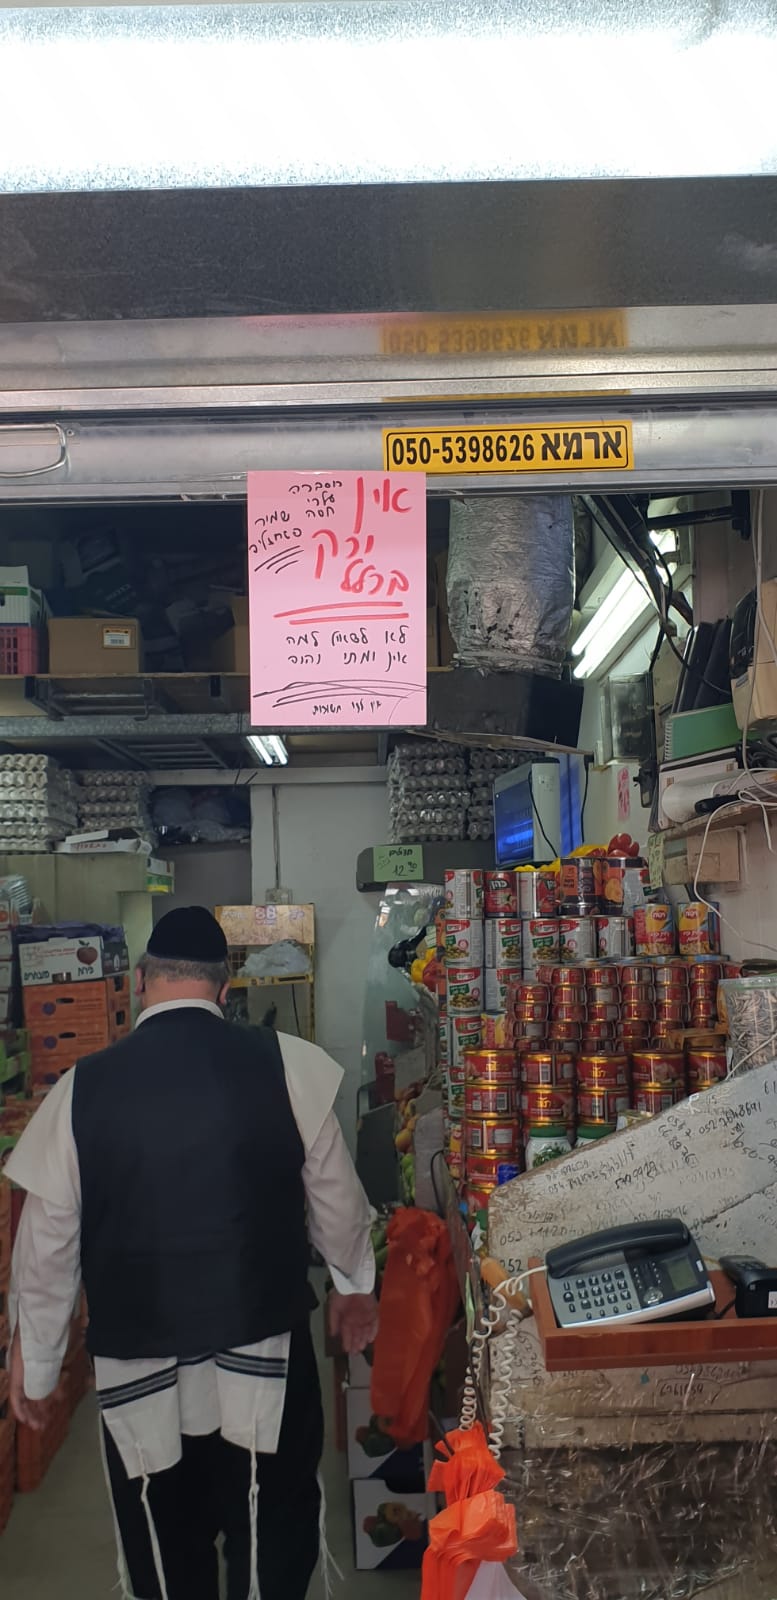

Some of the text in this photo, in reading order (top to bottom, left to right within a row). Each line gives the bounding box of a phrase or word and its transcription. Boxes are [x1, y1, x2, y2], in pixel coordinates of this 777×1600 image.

[391, 430, 623, 466] ארמא 050-5398626
[288, 480, 343, 495] כוסברה
[306, 490, 335, 506] סלרי
[353, 476, 412, 534] אין
[254, 510, 290, 527] שמיר
[305, 506, 335, 518] חסה
[311, 529, 374, 580] ירק
[340, 558, 410, 596] בכלל
[286, 631, 320, 647] למה
[385, 625, 409, 644] לא
[343, 650, 376, 665] ומתי
[385, 651, 407, 672] אין
